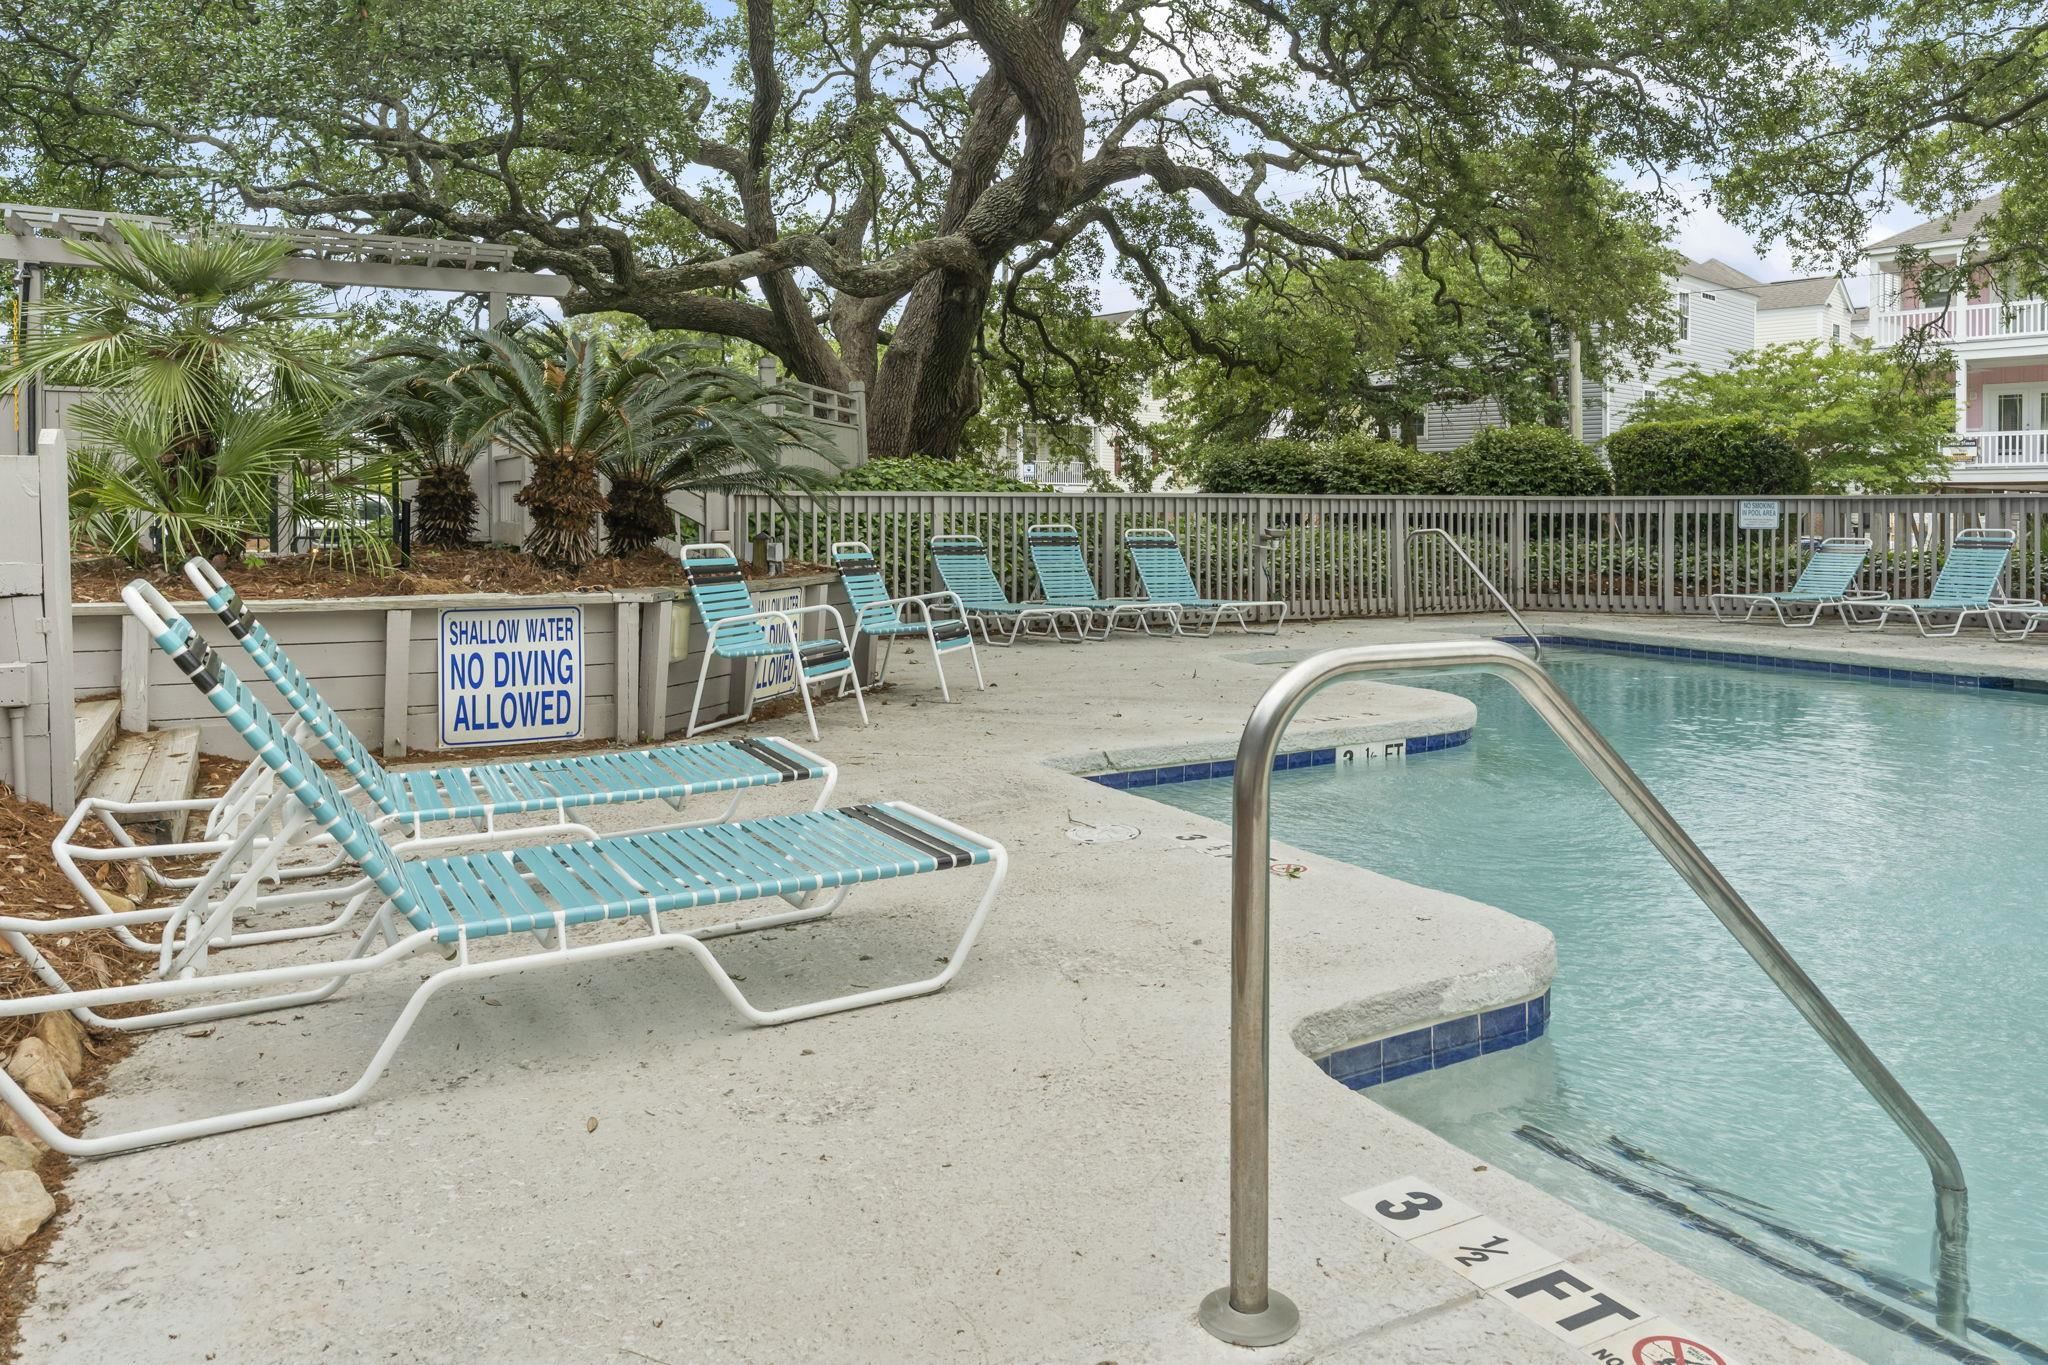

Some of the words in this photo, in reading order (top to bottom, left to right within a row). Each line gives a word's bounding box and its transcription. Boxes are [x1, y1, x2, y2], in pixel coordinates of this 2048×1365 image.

[450, 619, 519, 646] SHALLOW
[526, 617, 574, 643] WATER
[450, 652, 484, 690] NO
[494, 648, 573, 688] DIVING
[755, 653, 794, 689] LLOWED
[453, 689, 571, 732] ALLOWED
[1385, 743, 1404, 759] FT
[1375, 1191, 1443, 1220] 3
[1504, 1269, 1640, 1332] FT
[1591, 1348, 1625, 1365] NO
